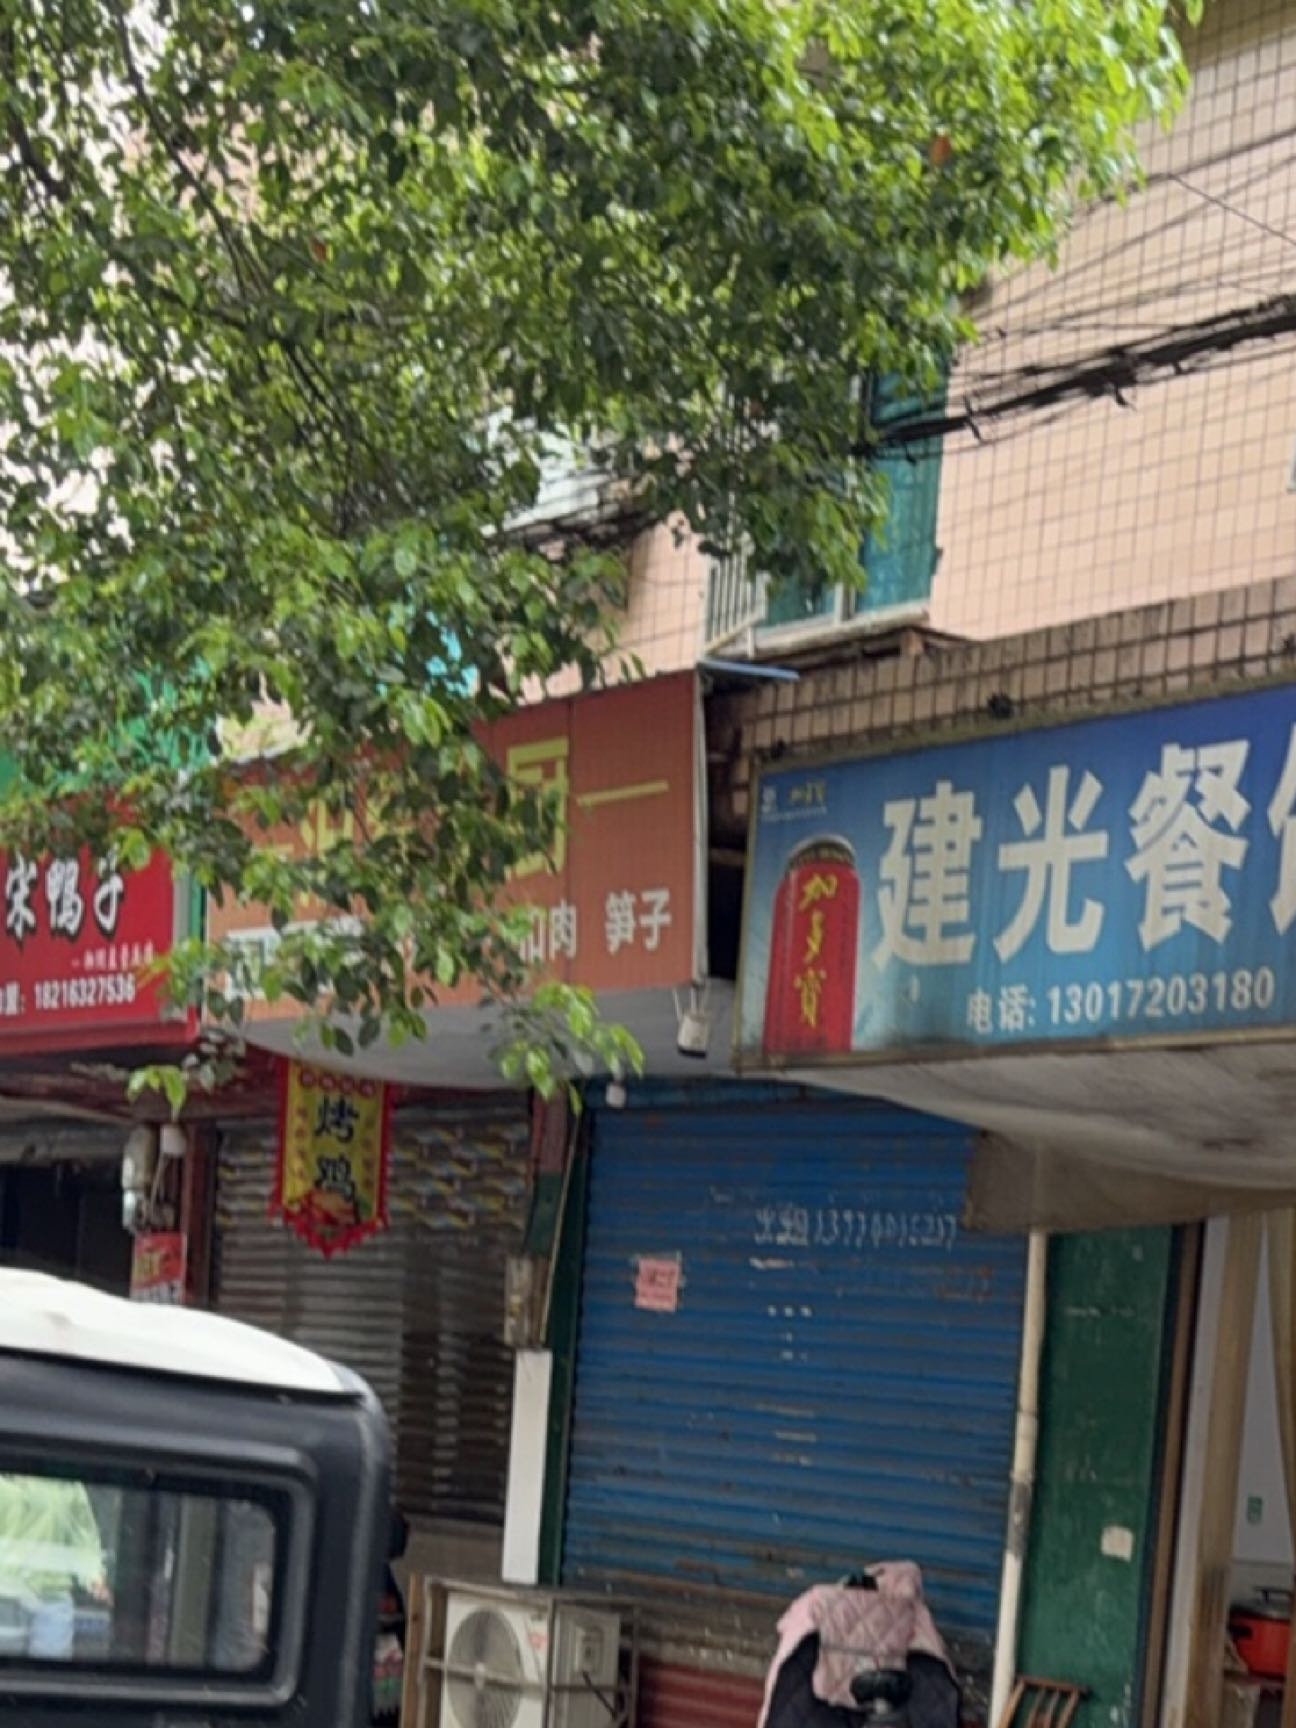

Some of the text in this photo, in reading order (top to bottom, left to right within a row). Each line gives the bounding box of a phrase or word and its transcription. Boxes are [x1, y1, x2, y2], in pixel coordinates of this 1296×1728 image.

[604, 888, 672, 955] 笋子
[966, 966, 1275, 1034] 电话: 13017203180
